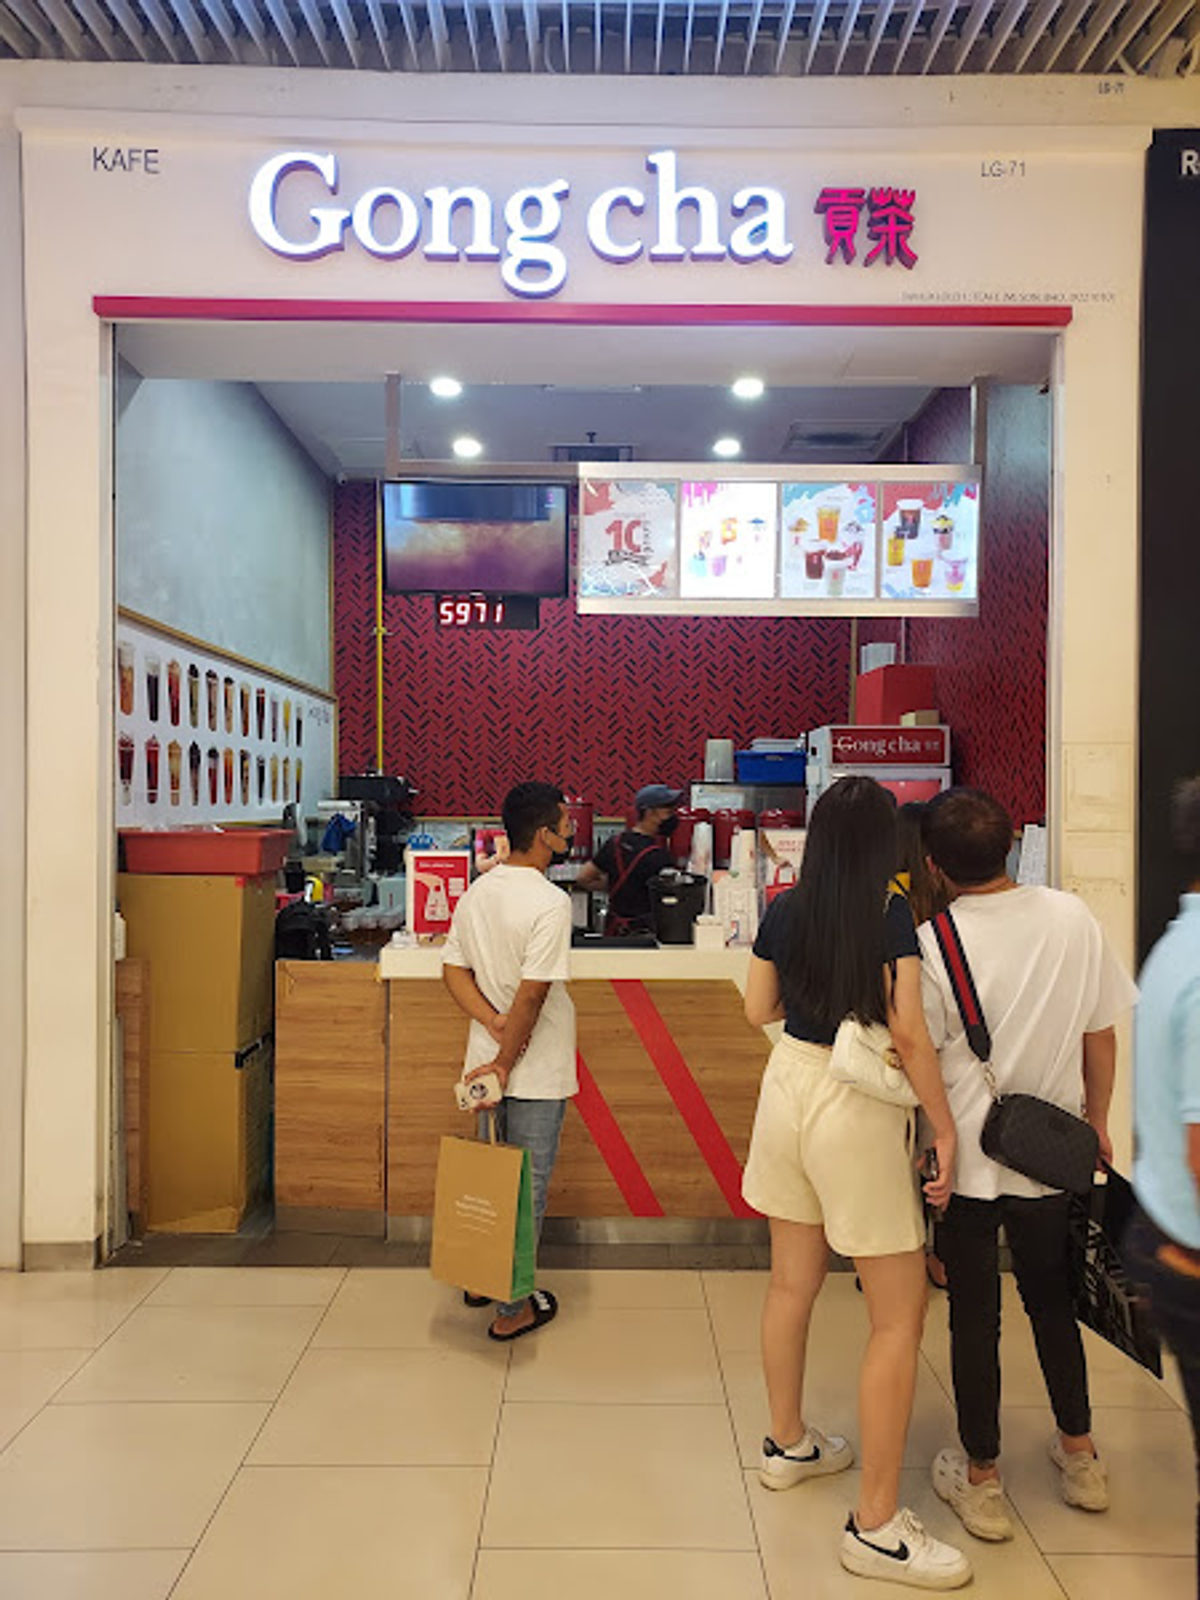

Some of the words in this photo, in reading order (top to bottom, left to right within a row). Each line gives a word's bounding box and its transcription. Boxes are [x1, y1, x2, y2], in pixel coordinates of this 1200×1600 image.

[93, 146, 160, 174] KAFE
[981, 160, 1026, 178] LG-71
[1181, 149, 1200, 175] R
[248, 151, 569, 298] Gong
[587, 150, 794, 264] cha
[438, 602, 504, 625] 5971
[837, 735, 887, 758] Gong
[888, 735, 921, 753] cha
